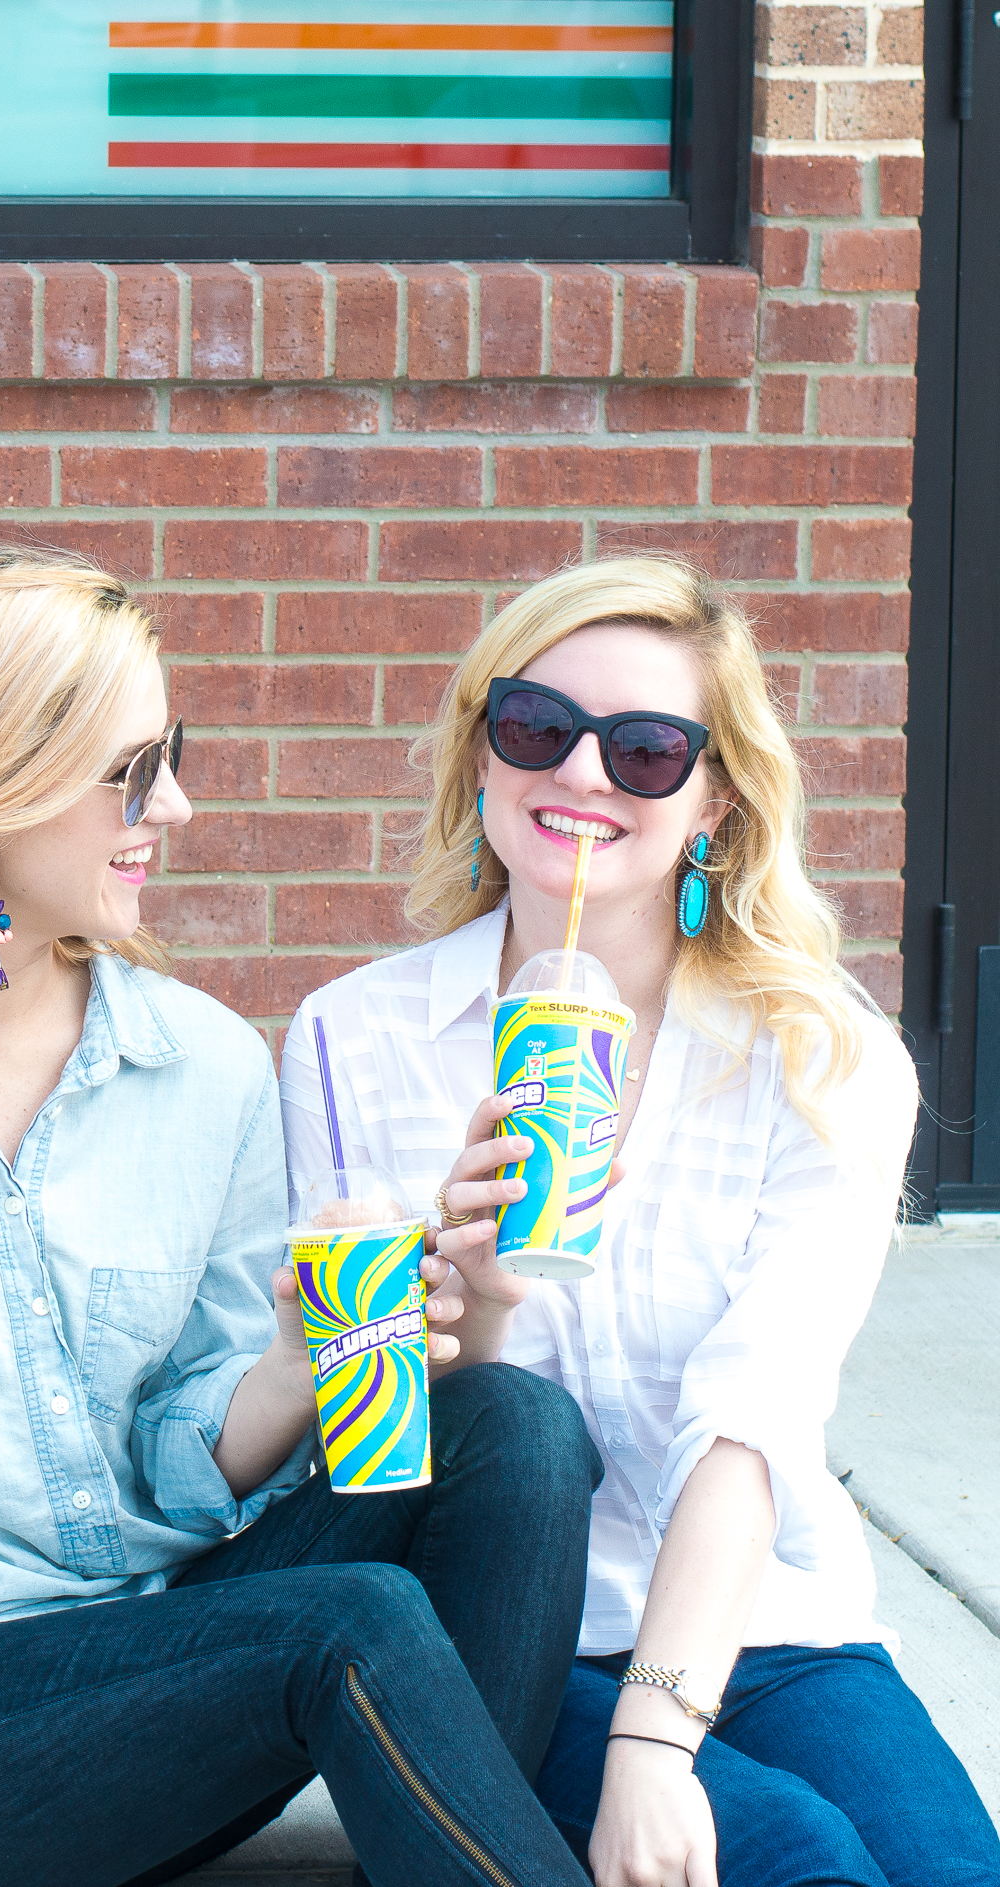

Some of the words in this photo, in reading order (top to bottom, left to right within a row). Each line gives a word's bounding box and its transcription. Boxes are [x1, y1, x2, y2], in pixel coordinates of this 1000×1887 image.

[548, 1003, 588, 1014] SLURP
[527, 1039, 547, 1049] Only
[531, 1047, 541, 1055] At
[385, 1467, 413, 1477] Medium
